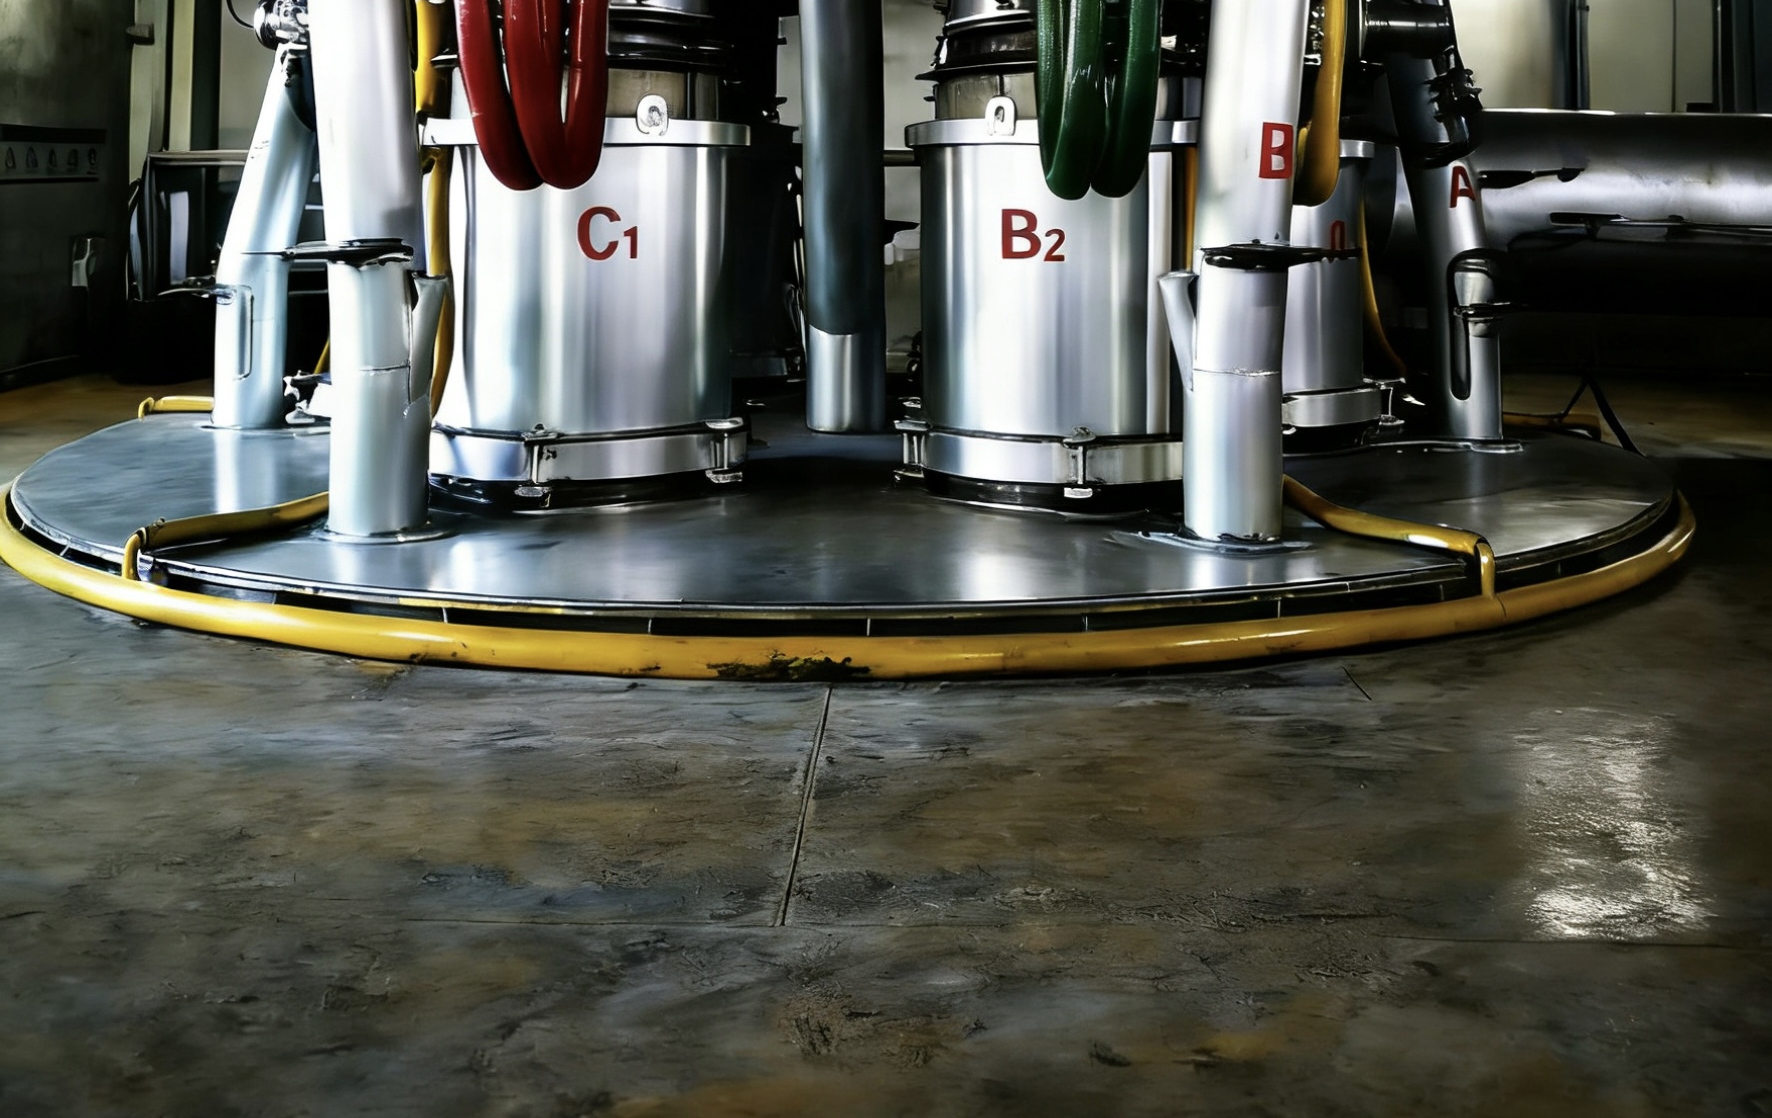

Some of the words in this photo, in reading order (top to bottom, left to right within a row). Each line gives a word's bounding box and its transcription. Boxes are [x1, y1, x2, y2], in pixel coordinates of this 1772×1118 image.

[1259, 121, 1294, 179] B
[1449, 165, 1476, 209] A
[577, 206, 638, 261] C1
[1001, 208, 1066, 262] B2
